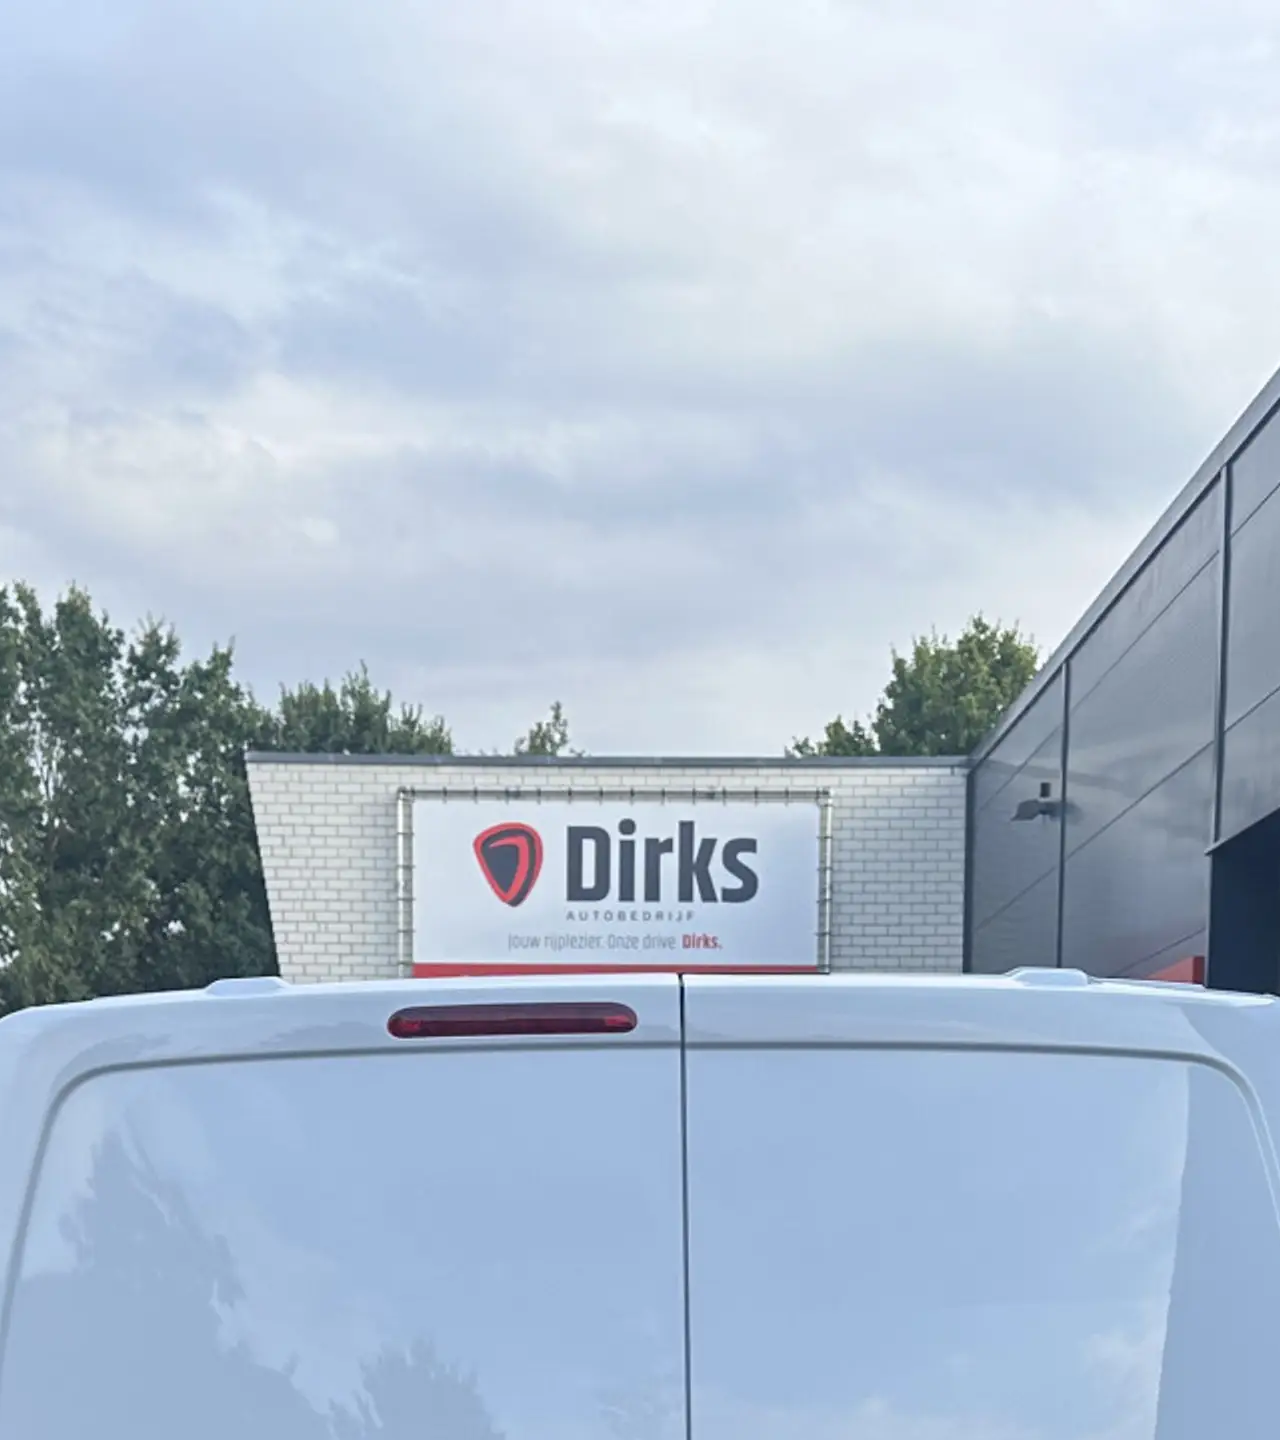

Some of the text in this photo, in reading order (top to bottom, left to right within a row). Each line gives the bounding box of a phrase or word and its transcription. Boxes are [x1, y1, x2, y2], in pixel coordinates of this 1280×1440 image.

[566, 818, 759, 903] Dirks
[566, 910, 694, 922] AUTOBEDRIJF
[608, 934, 640, 949] Onze
[642, 933, 676, 949] drive
[682, 932, 723, 949] Dirks.
